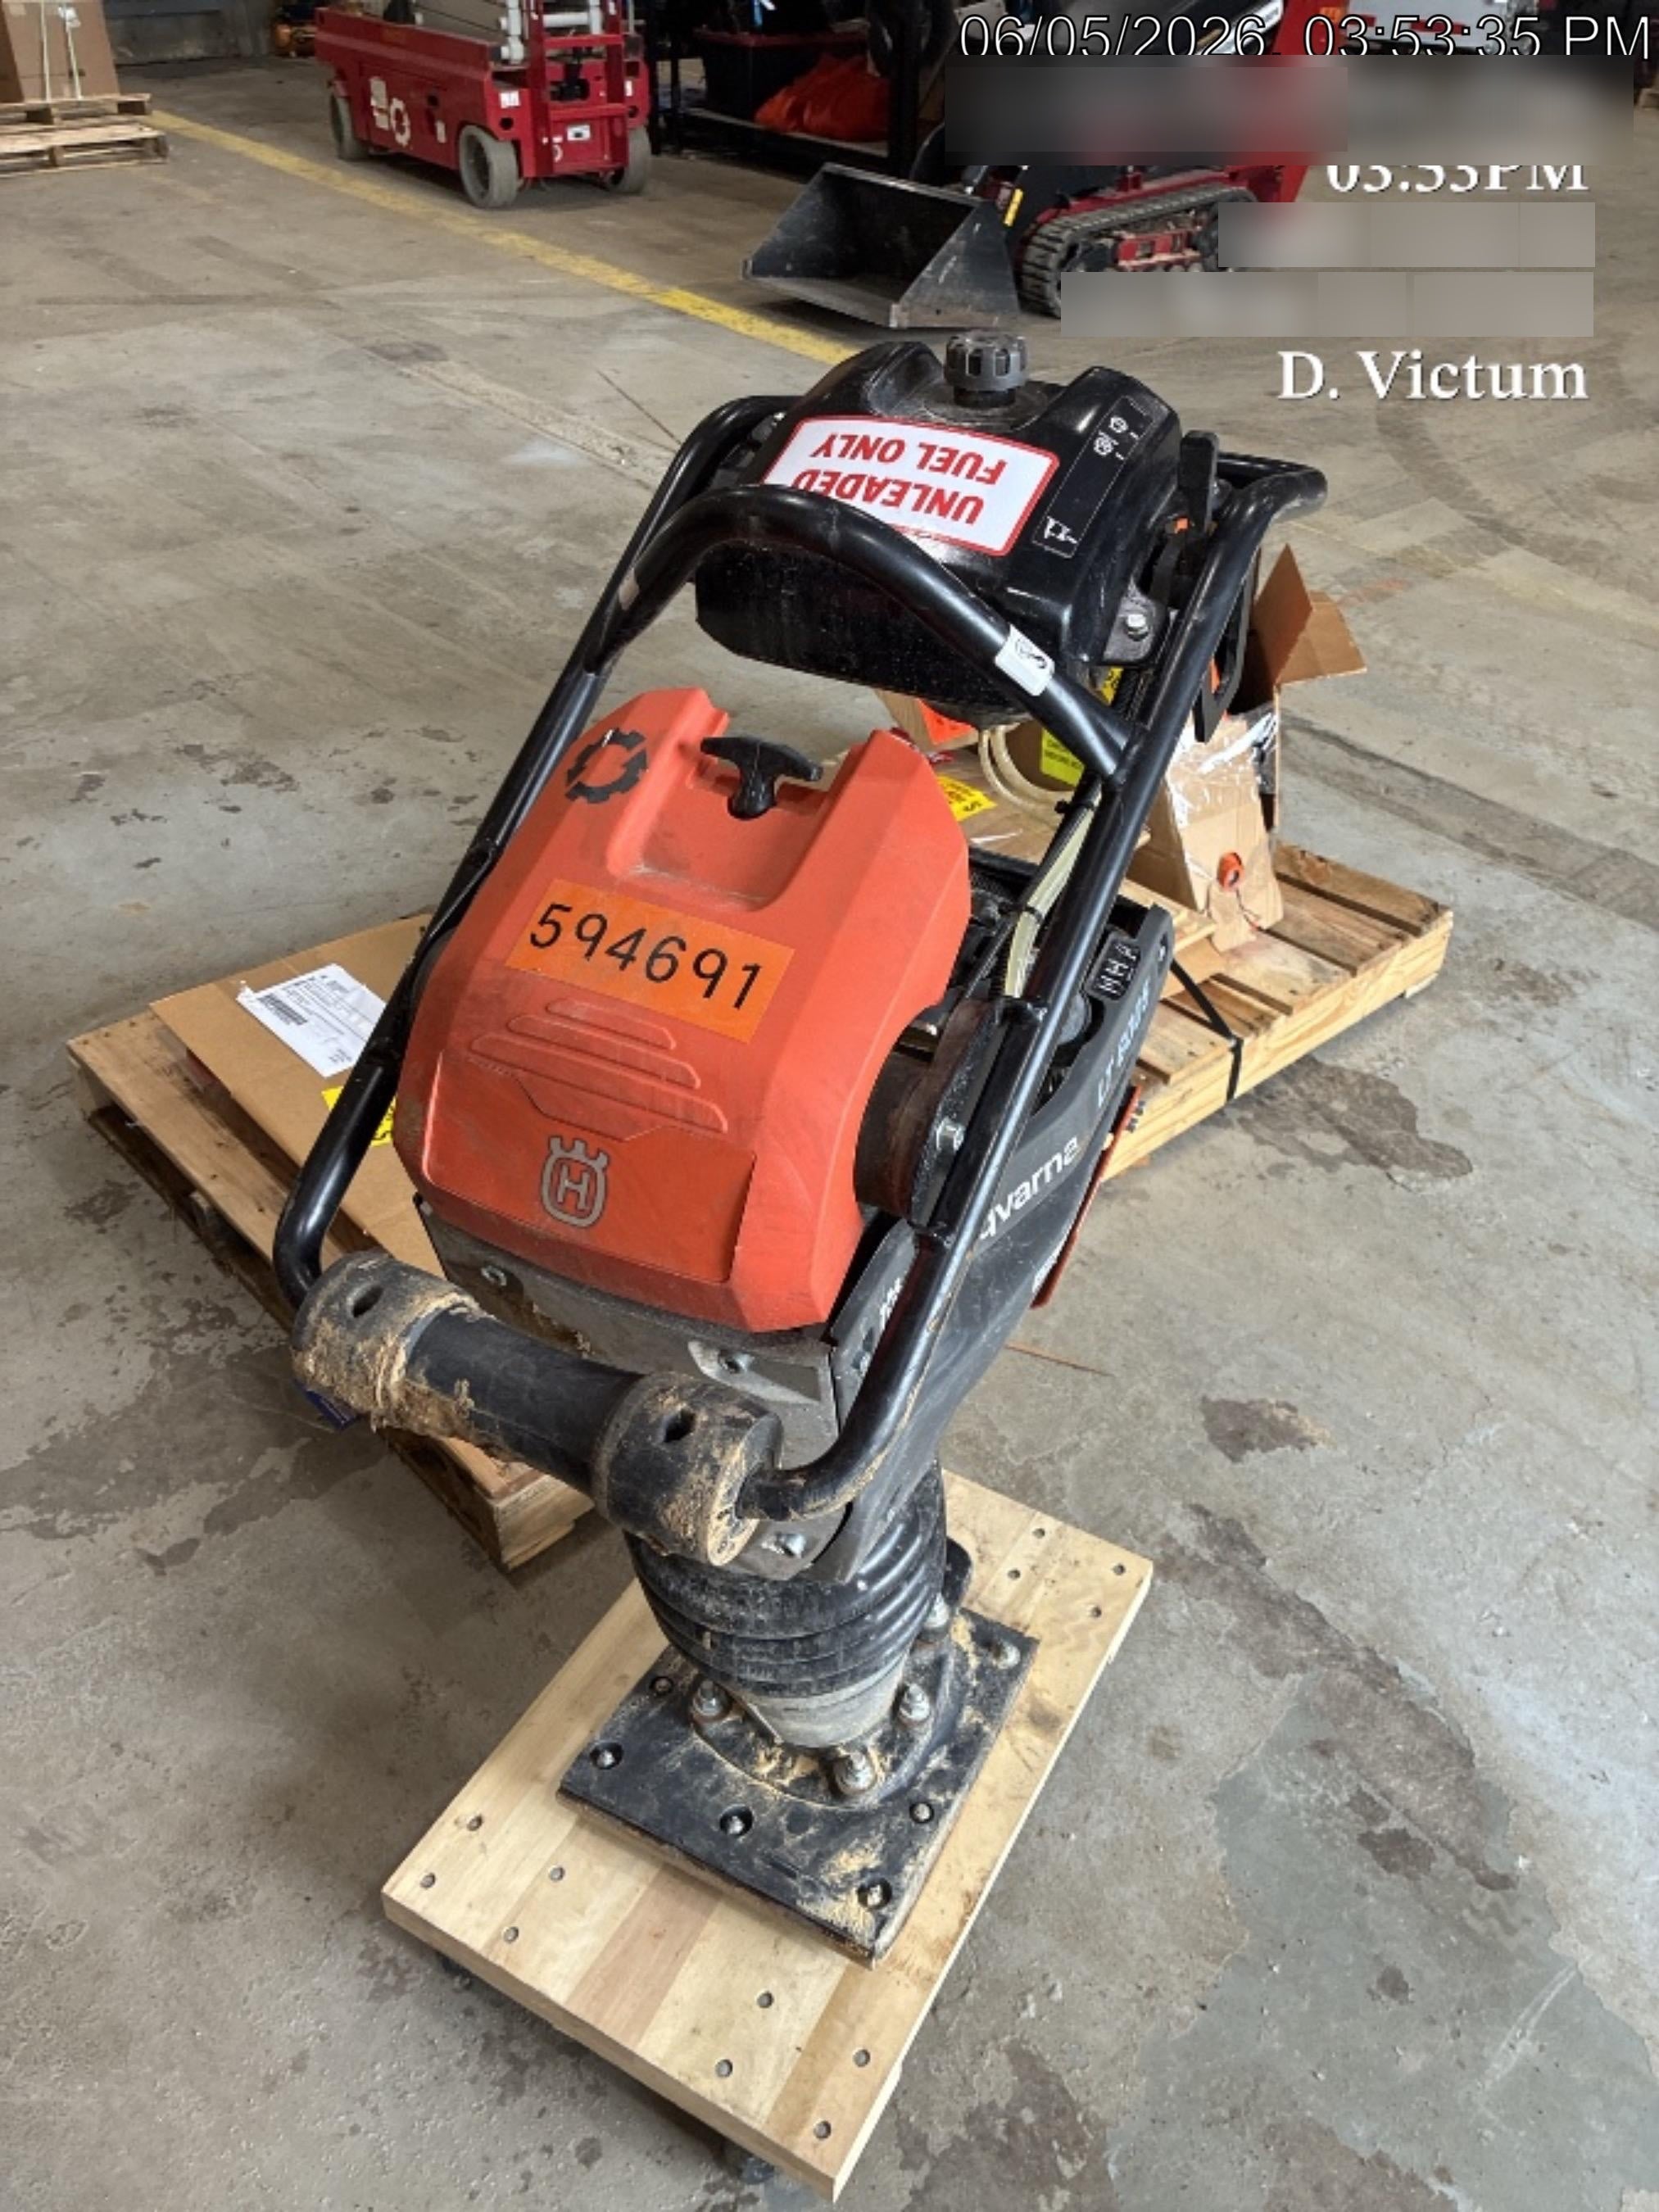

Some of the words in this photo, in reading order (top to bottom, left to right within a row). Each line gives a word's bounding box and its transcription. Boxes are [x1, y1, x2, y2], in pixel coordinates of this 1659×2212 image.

[809, 432, 906, 465] ONLY
[916, 442, 1009, 486] FUEL
[790, 469, 985, 525] UNLEADED
[529, 902, 763, 1010] 594691
[979, 1135, 1080, 1240] qvarna
